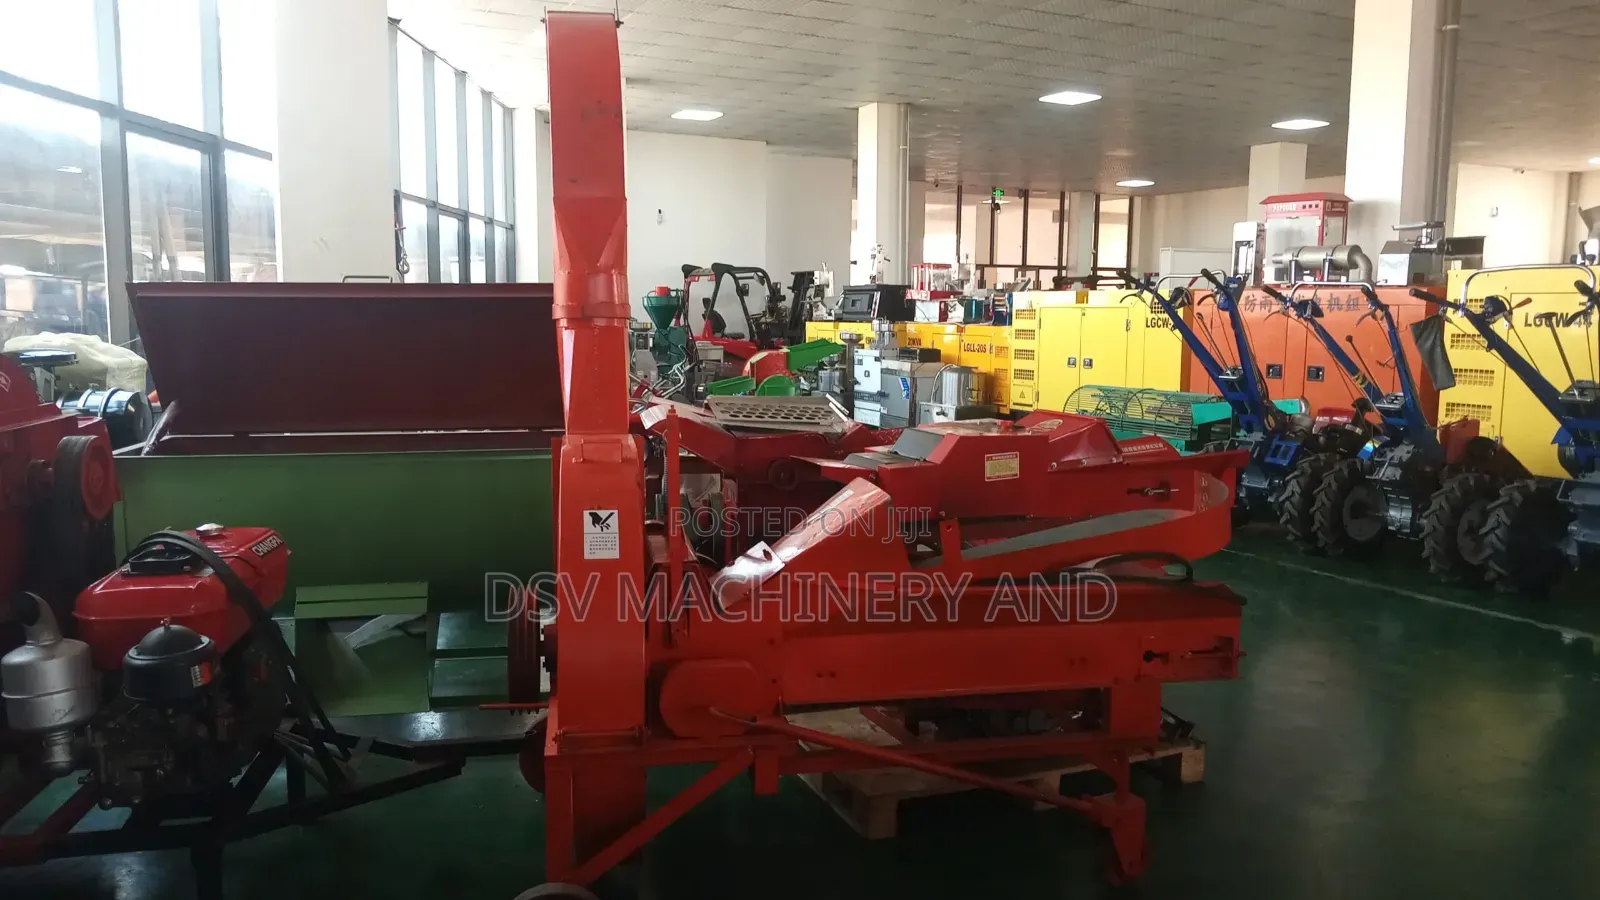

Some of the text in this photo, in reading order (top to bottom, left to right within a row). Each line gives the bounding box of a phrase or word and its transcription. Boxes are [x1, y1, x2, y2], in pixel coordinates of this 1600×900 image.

[1244, 293, 1361, 314] 防雨机组
[1145, 317, 1172, 329] LGCW-
